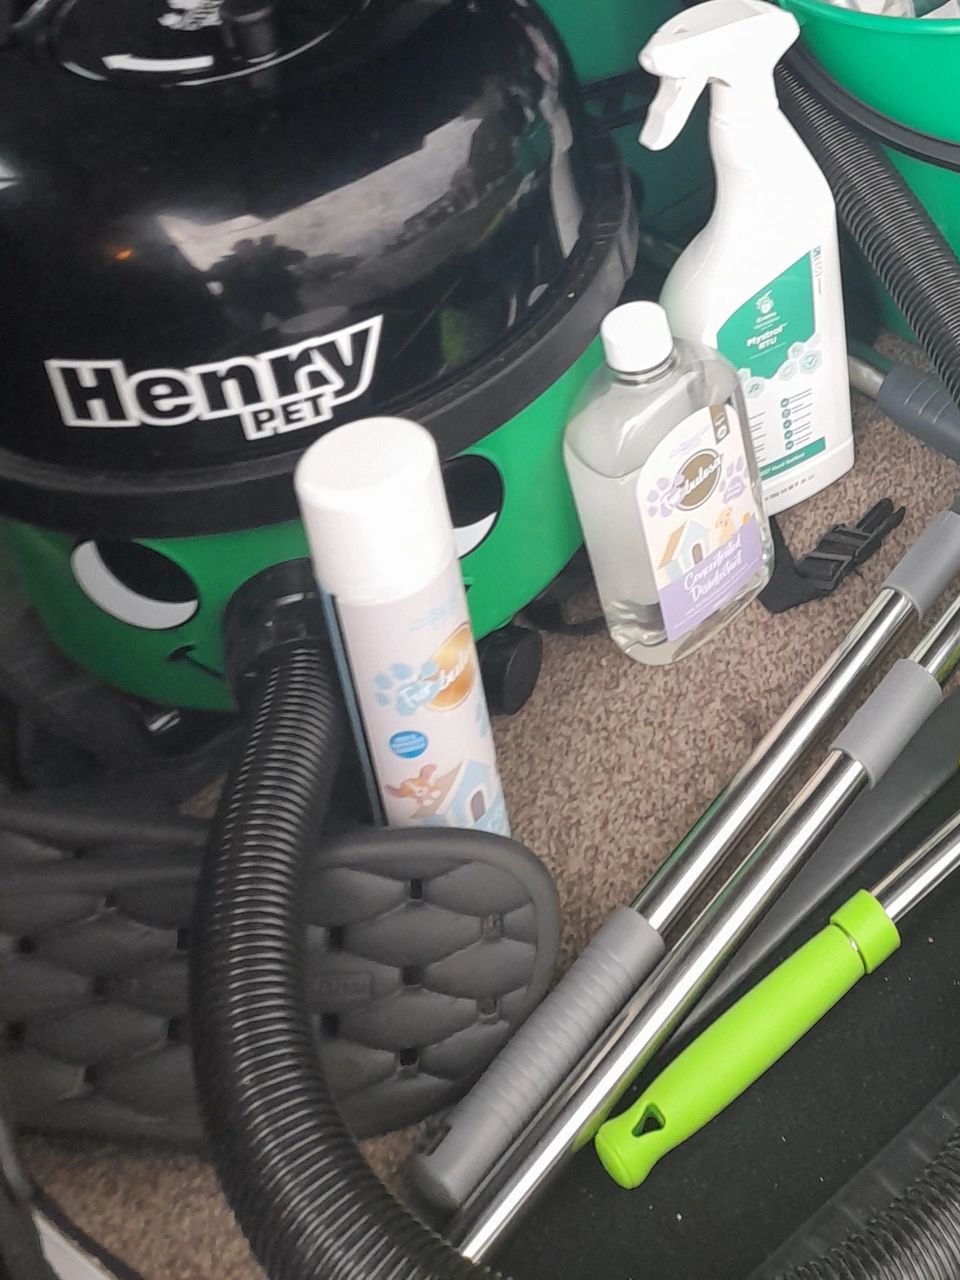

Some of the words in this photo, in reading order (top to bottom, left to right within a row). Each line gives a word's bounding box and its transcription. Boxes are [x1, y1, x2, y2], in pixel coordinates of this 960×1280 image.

[44, 315, 383, 427] Henry
[246, 393, 330, 437] PET
[684, 534, 742, 591] Concentrated
[690, 550, 743, 602] Disinfectant
